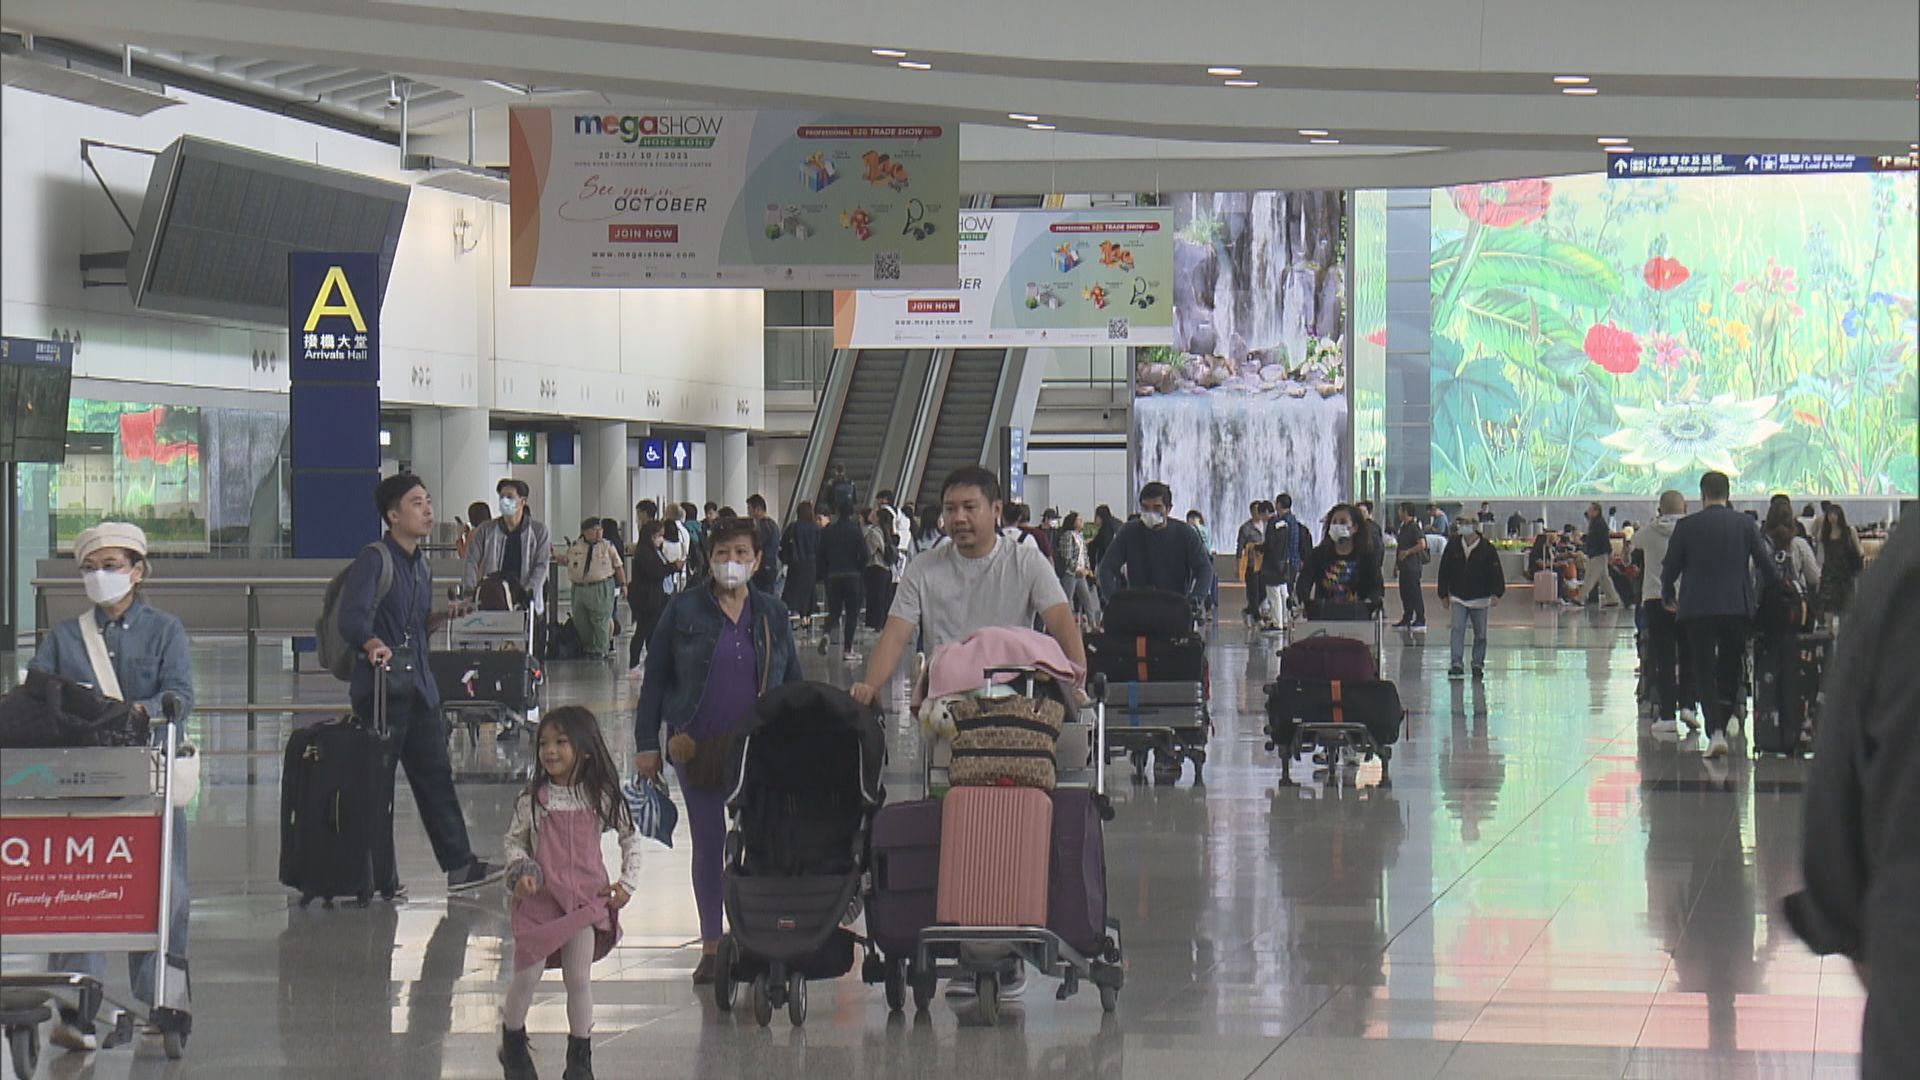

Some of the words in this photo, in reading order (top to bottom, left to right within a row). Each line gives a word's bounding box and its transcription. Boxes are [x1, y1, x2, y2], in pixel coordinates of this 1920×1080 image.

[870, 128, 896, 136] TRADE
[898, 128, 922, 136] SHOW
[644, 138, 675, 146] HONG
[680, 138, 711, 146] KONG
[579, 174, 616, 200] See
[614, 198, 707, 212] OCTOBER
[614, 229, 642, 238] JOIN
[646, 229, 673, 238] NOW
[303, 266, 368, 331] A
[912, 302, 933, 310] JOIN
[935, 302, 956, 310] NOW
[304, 350, 345, 360] Arrivals
[348, 350, 368, 360] Hall
